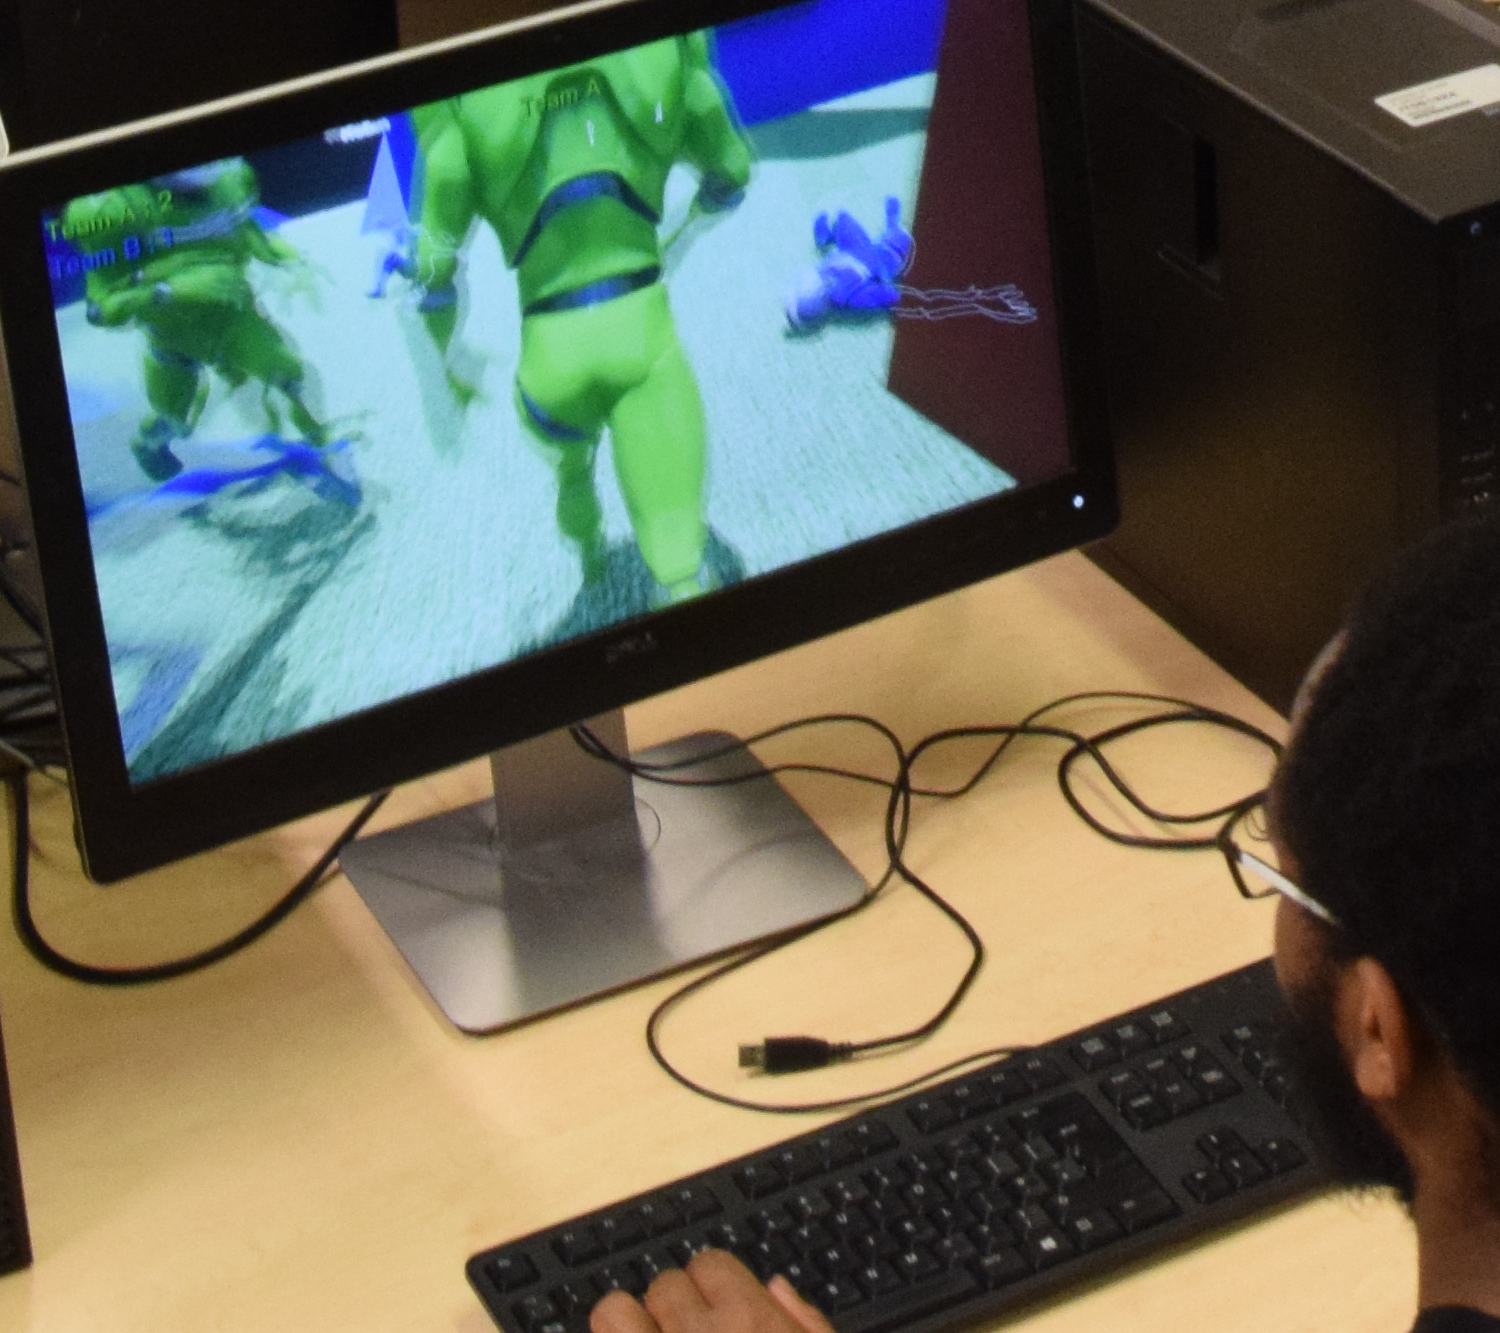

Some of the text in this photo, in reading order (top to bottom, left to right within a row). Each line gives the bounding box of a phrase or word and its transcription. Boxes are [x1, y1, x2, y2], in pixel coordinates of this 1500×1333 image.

[45, 212, 114, 242] Team
[157, 188, 174, 215] 2
[51, 246, 116, 281] Team
